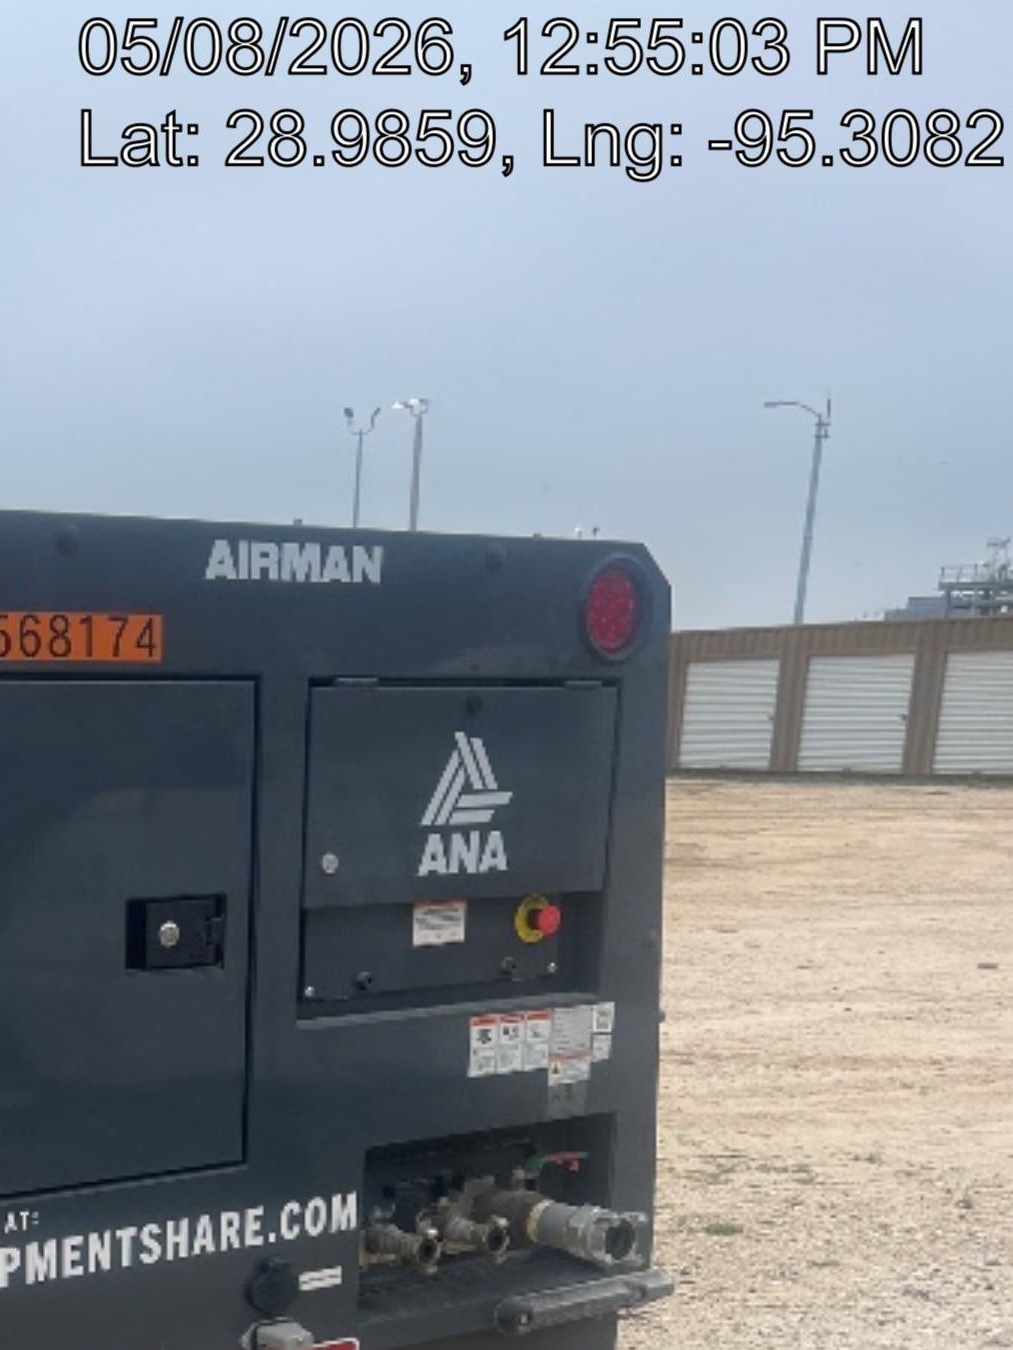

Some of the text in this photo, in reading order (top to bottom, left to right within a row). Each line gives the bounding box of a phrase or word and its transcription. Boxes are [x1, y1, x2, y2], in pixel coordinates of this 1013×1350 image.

[205, 539, 384, 585] AIRMAN
[416, 830, 508, 877] ANA
[4, 1210, 40, 1235] AT:
